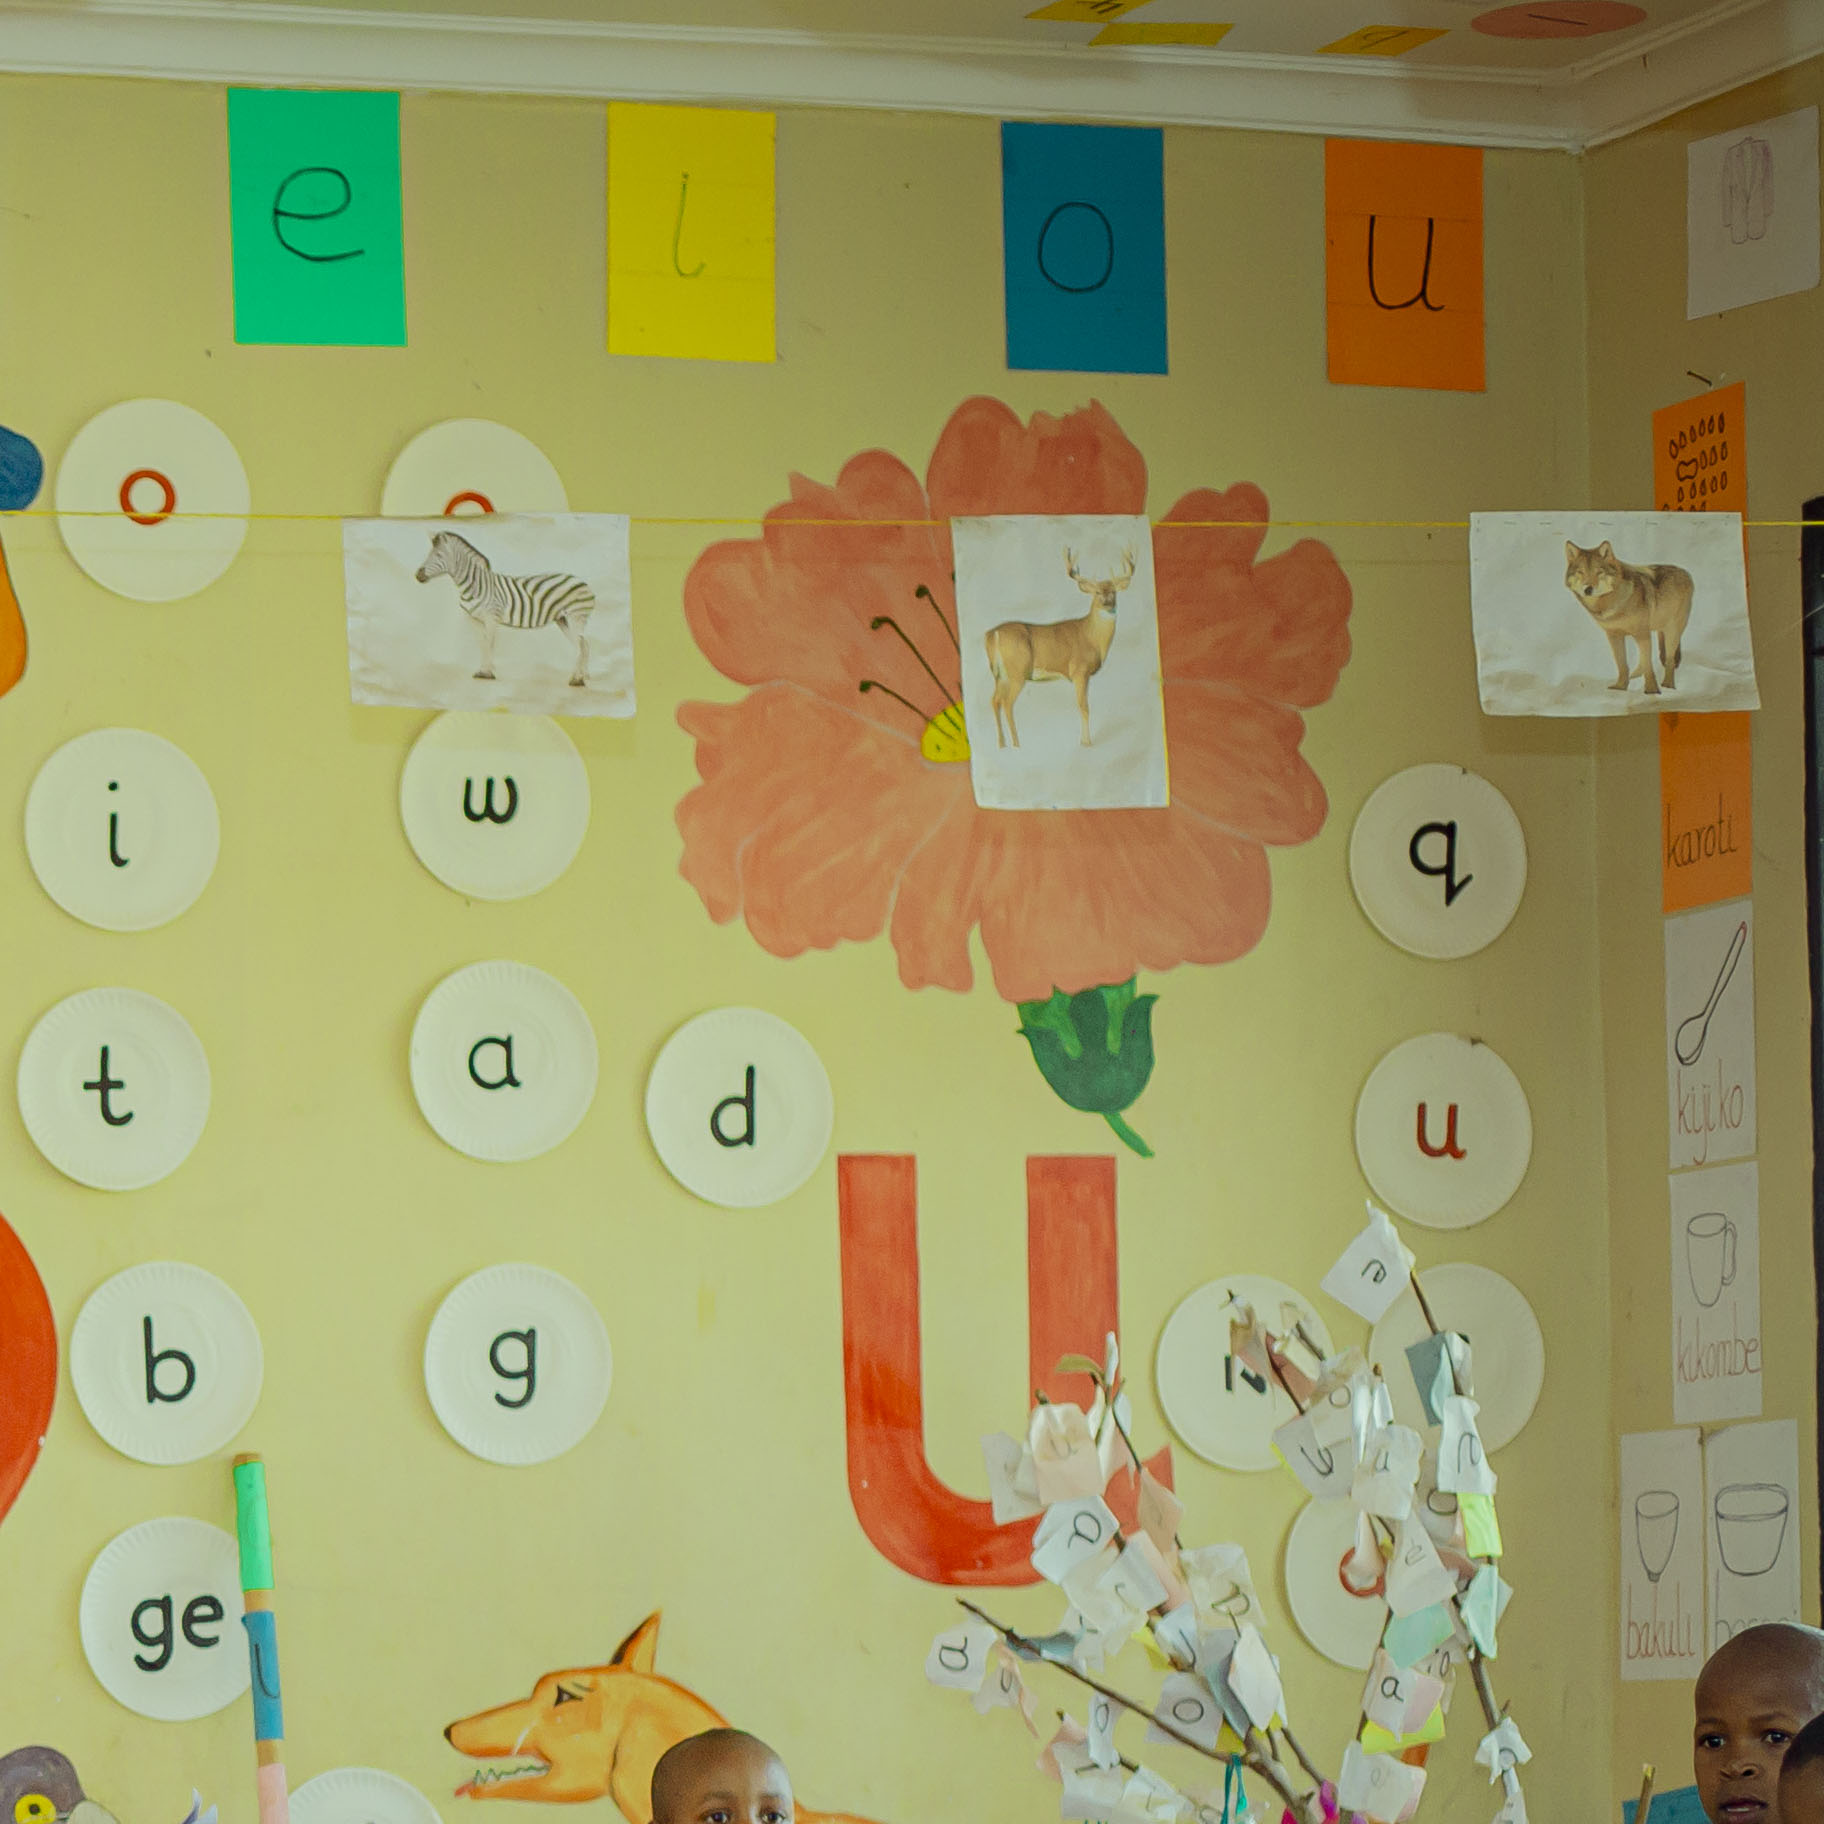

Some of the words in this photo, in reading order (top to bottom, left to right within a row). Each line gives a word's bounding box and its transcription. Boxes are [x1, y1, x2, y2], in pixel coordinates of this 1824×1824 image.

[273, 166, 365, 261] e
[1369, 214, 1446, 311] u
[120, 469, 176, 526] o
[108, 781, 130, 868] i
[462, 775, 519, 825] w
[1667, 792, 1737, 868] karoti
[1409, 820, 1473, 907] q
[83, 1045, 134, 1127] t
[468, 1034, 521, 1091] a
[711, 1065, 756, 1148] d
[1416, 1101, 1467, 1160] u
[1676, 1058, 1745, 1165] kijiko
[143, 1316, 197, 1404] b
[489, 1326, 537, 1408] g
[130, 1590, 225, 1673] ge
[1626, 1580, 1696, 1660] bakuli
